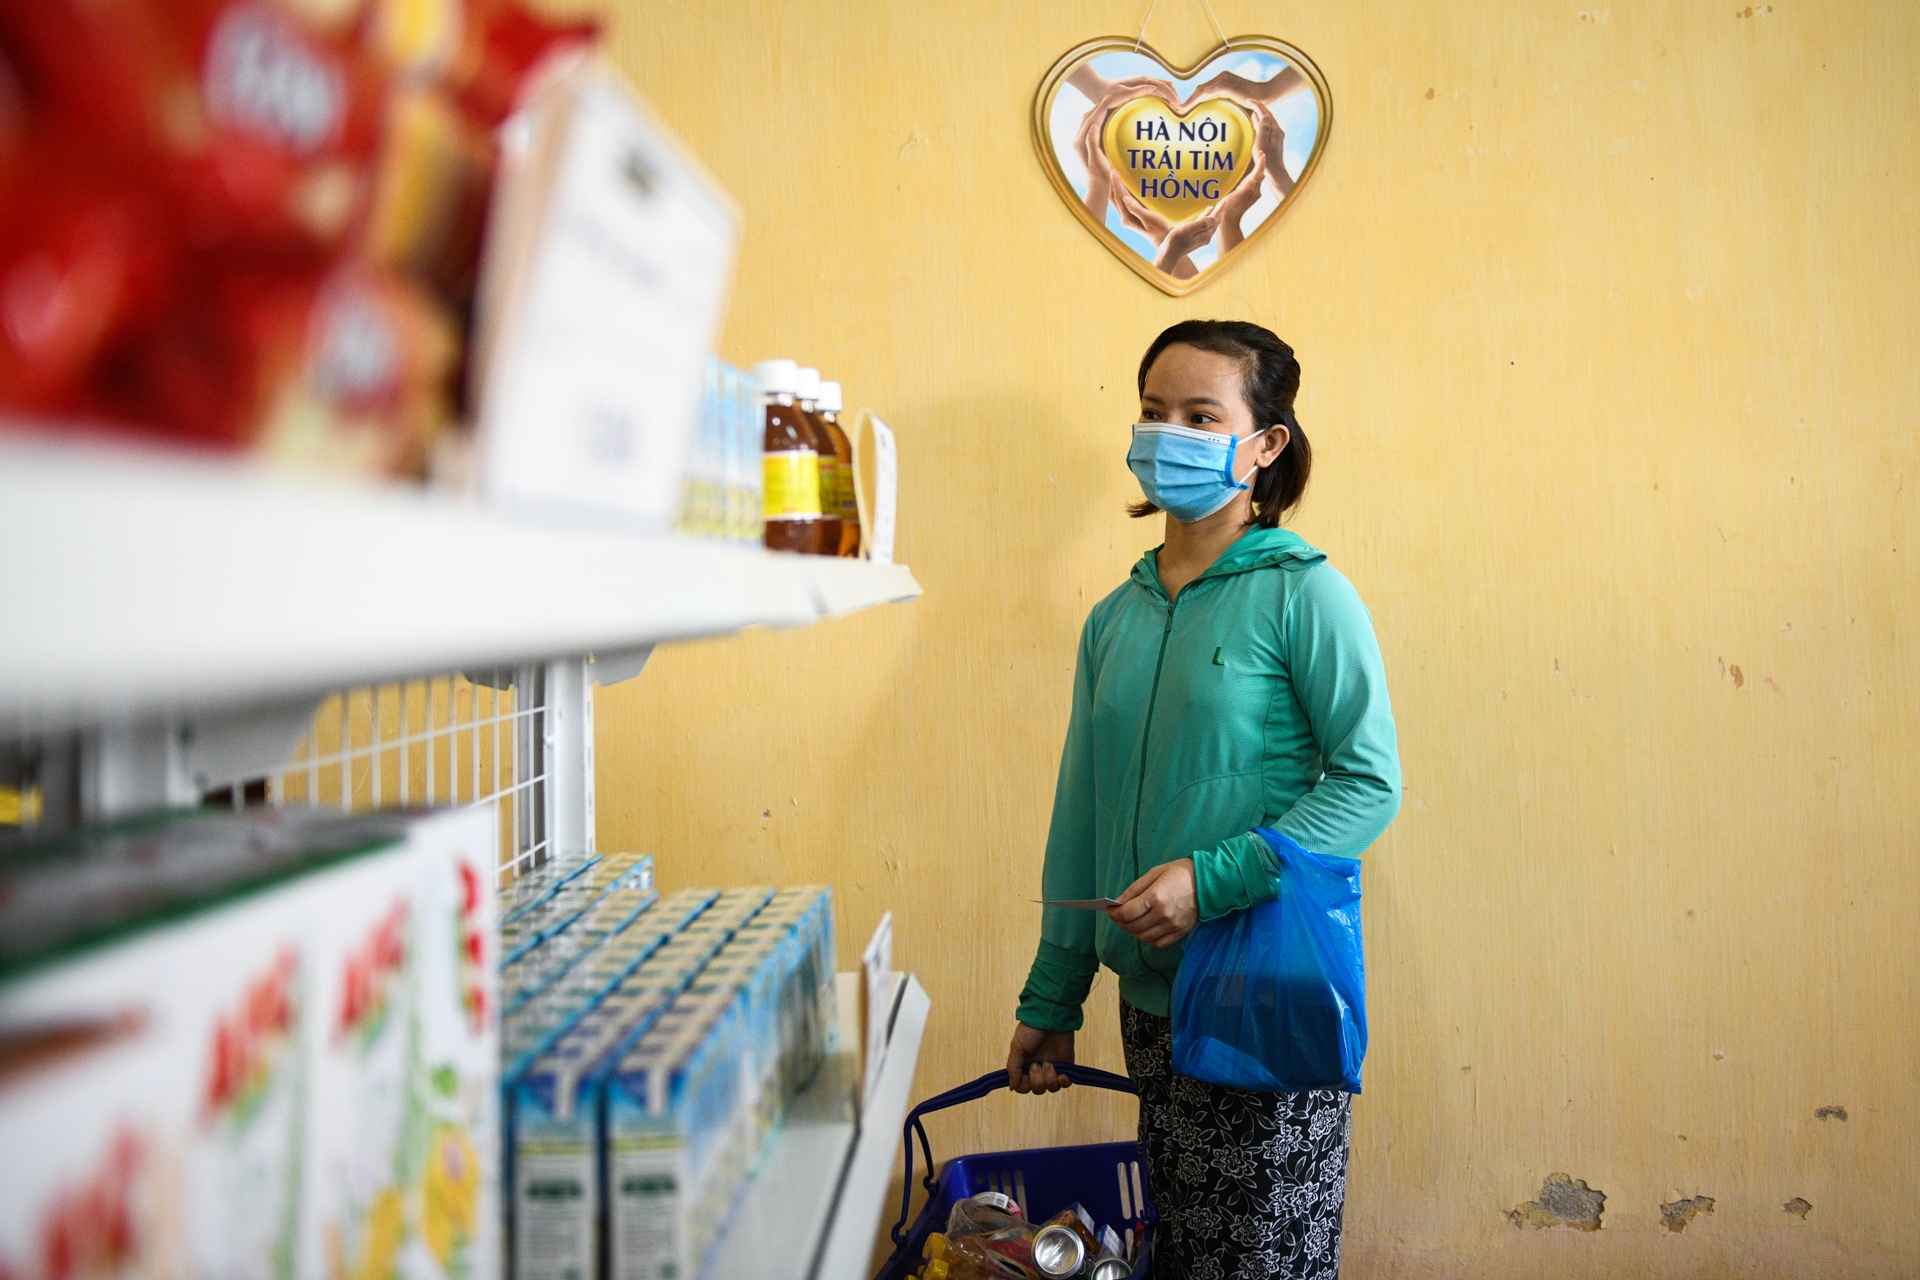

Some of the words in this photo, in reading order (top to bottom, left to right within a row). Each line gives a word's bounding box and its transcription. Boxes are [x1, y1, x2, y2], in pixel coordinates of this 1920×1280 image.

[1136, 116, 1170, 141] HÀ
[1178, 117, 1227, 148] NỘI
[1126, 145, 1181, 170] TRÁI
[1189, 150, 1234, 171] TIM
[1140, 170, 1220, 200] HỒNG
